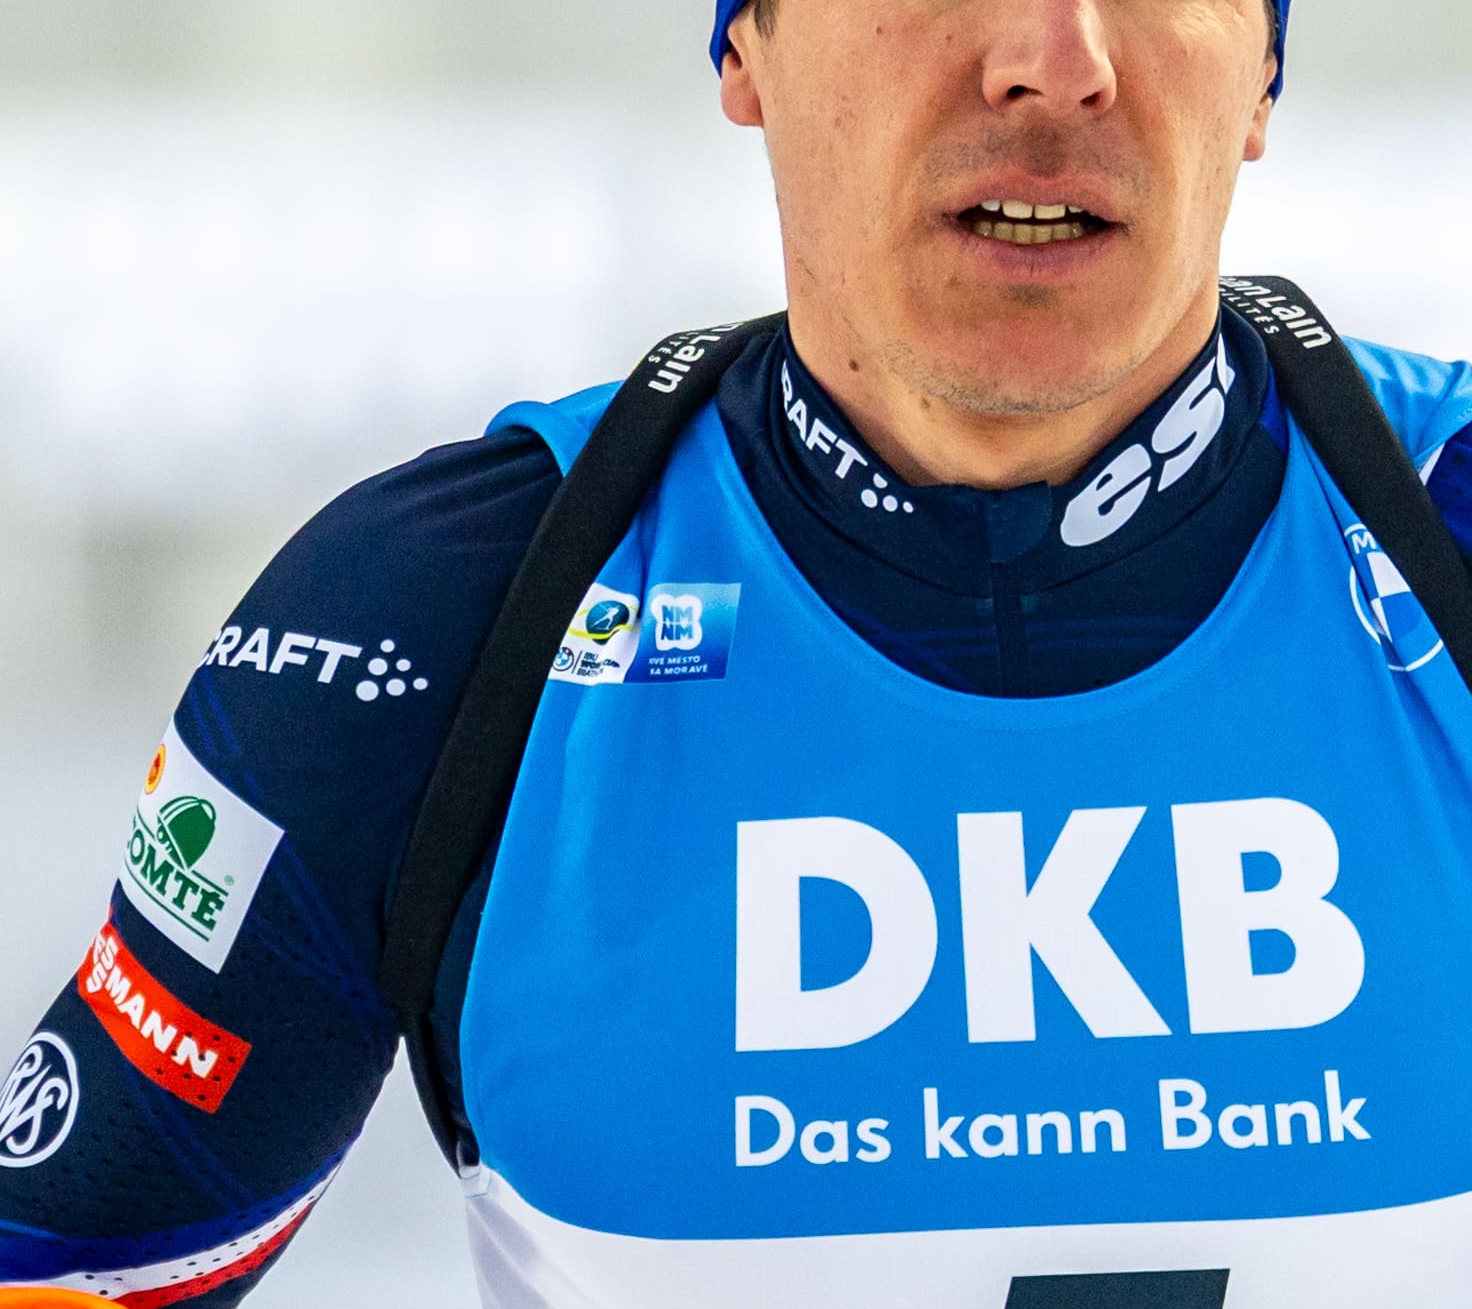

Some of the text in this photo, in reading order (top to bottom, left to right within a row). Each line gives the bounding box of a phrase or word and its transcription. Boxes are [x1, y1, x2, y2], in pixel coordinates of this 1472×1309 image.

[735, 796, 1366, 1052] DKB
[734, 1068, 1372, 1168] Das kann Bank
